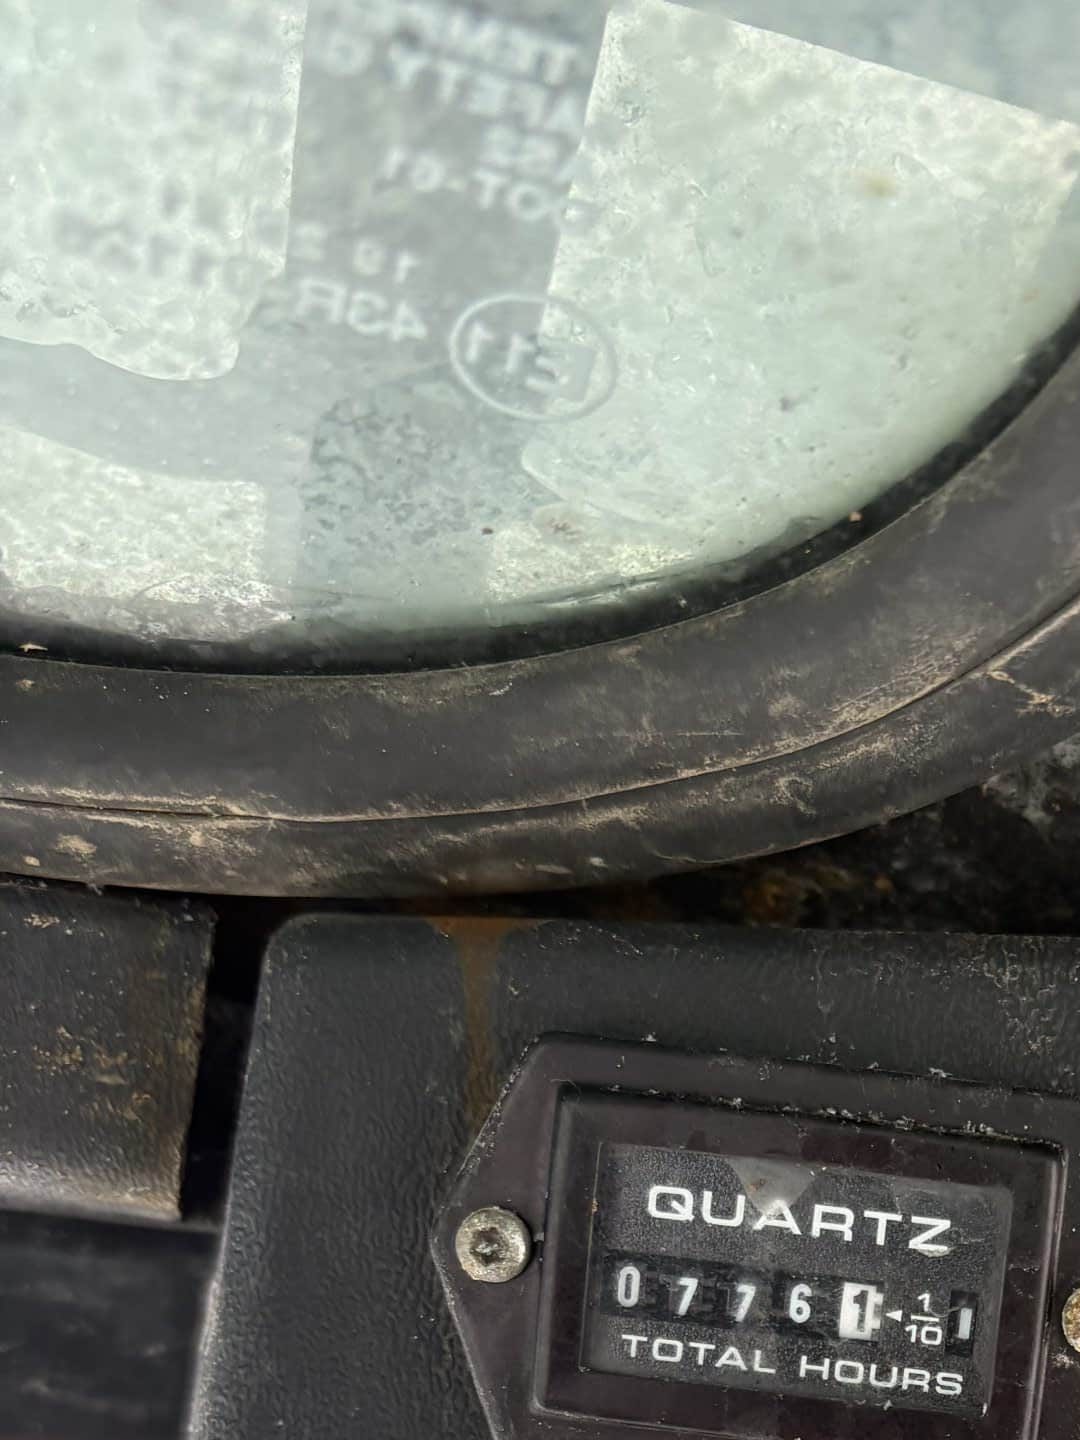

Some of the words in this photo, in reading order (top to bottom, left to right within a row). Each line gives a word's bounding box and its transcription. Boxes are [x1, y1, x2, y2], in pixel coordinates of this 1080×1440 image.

[647, 1184, 952, 1252] QUARTZ
[621, 1333, 776, 1375] TOTAL
[799, 1354, 964, 1396] HOURS
